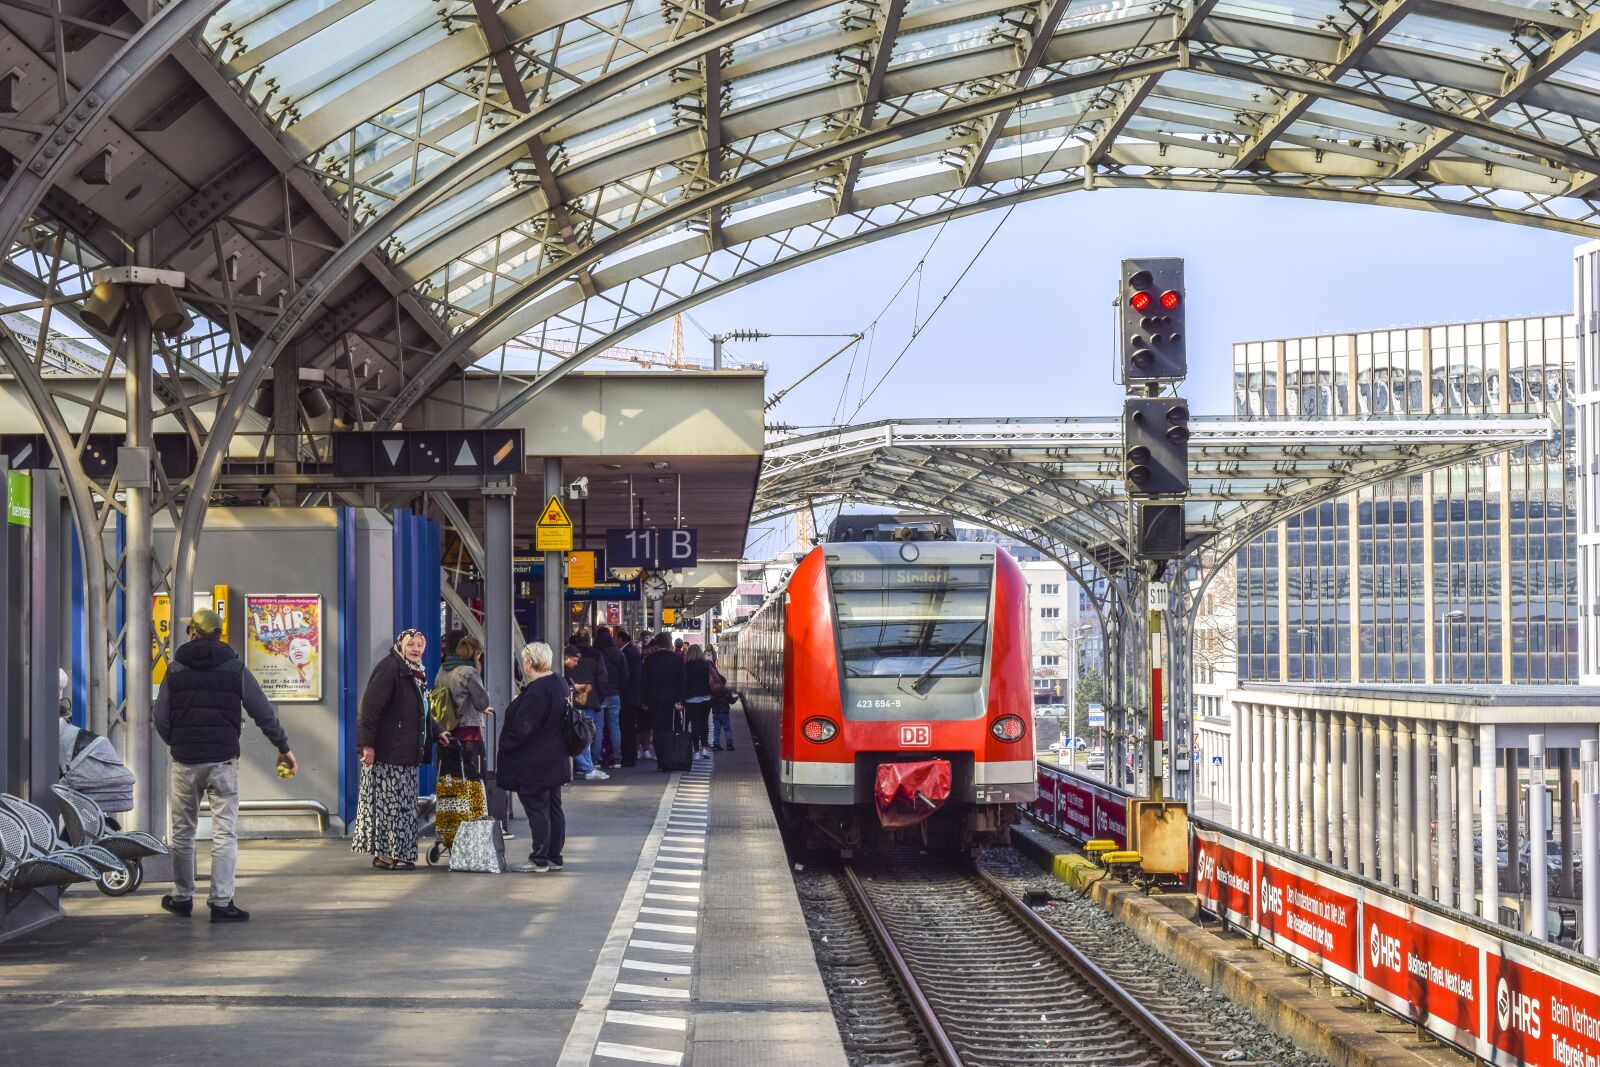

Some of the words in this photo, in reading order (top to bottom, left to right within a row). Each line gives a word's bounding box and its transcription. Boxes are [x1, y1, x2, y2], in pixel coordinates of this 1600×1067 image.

[625, 530, 650, 559] 11
[672, 530, 692, 559] B
[626, 584, 636, 592] 11
[842, 570, 865, 583] S19
[896, 570, 949, 583] Sindorf
[857, 700, 873, 708] 423
[875, 700, 901, 708] 694-9
[903, 728, 927, 743] DB
[1268, 884, 1283, 916] HRS
[1381, 933, 1401, 973] HRS
[1407, 952, 1428, 979] Business
[1428, 961, 1445, 987] Travel.
[1445, 968, 1457, 993] Next
[1457, 974, 1474, 1001] Level.
[1512, 990, 1541, 1039] HRS
[1551, 995, 1570, 1028] Beim
[1551, 1033, 1584, 1067] Tiefpreis
